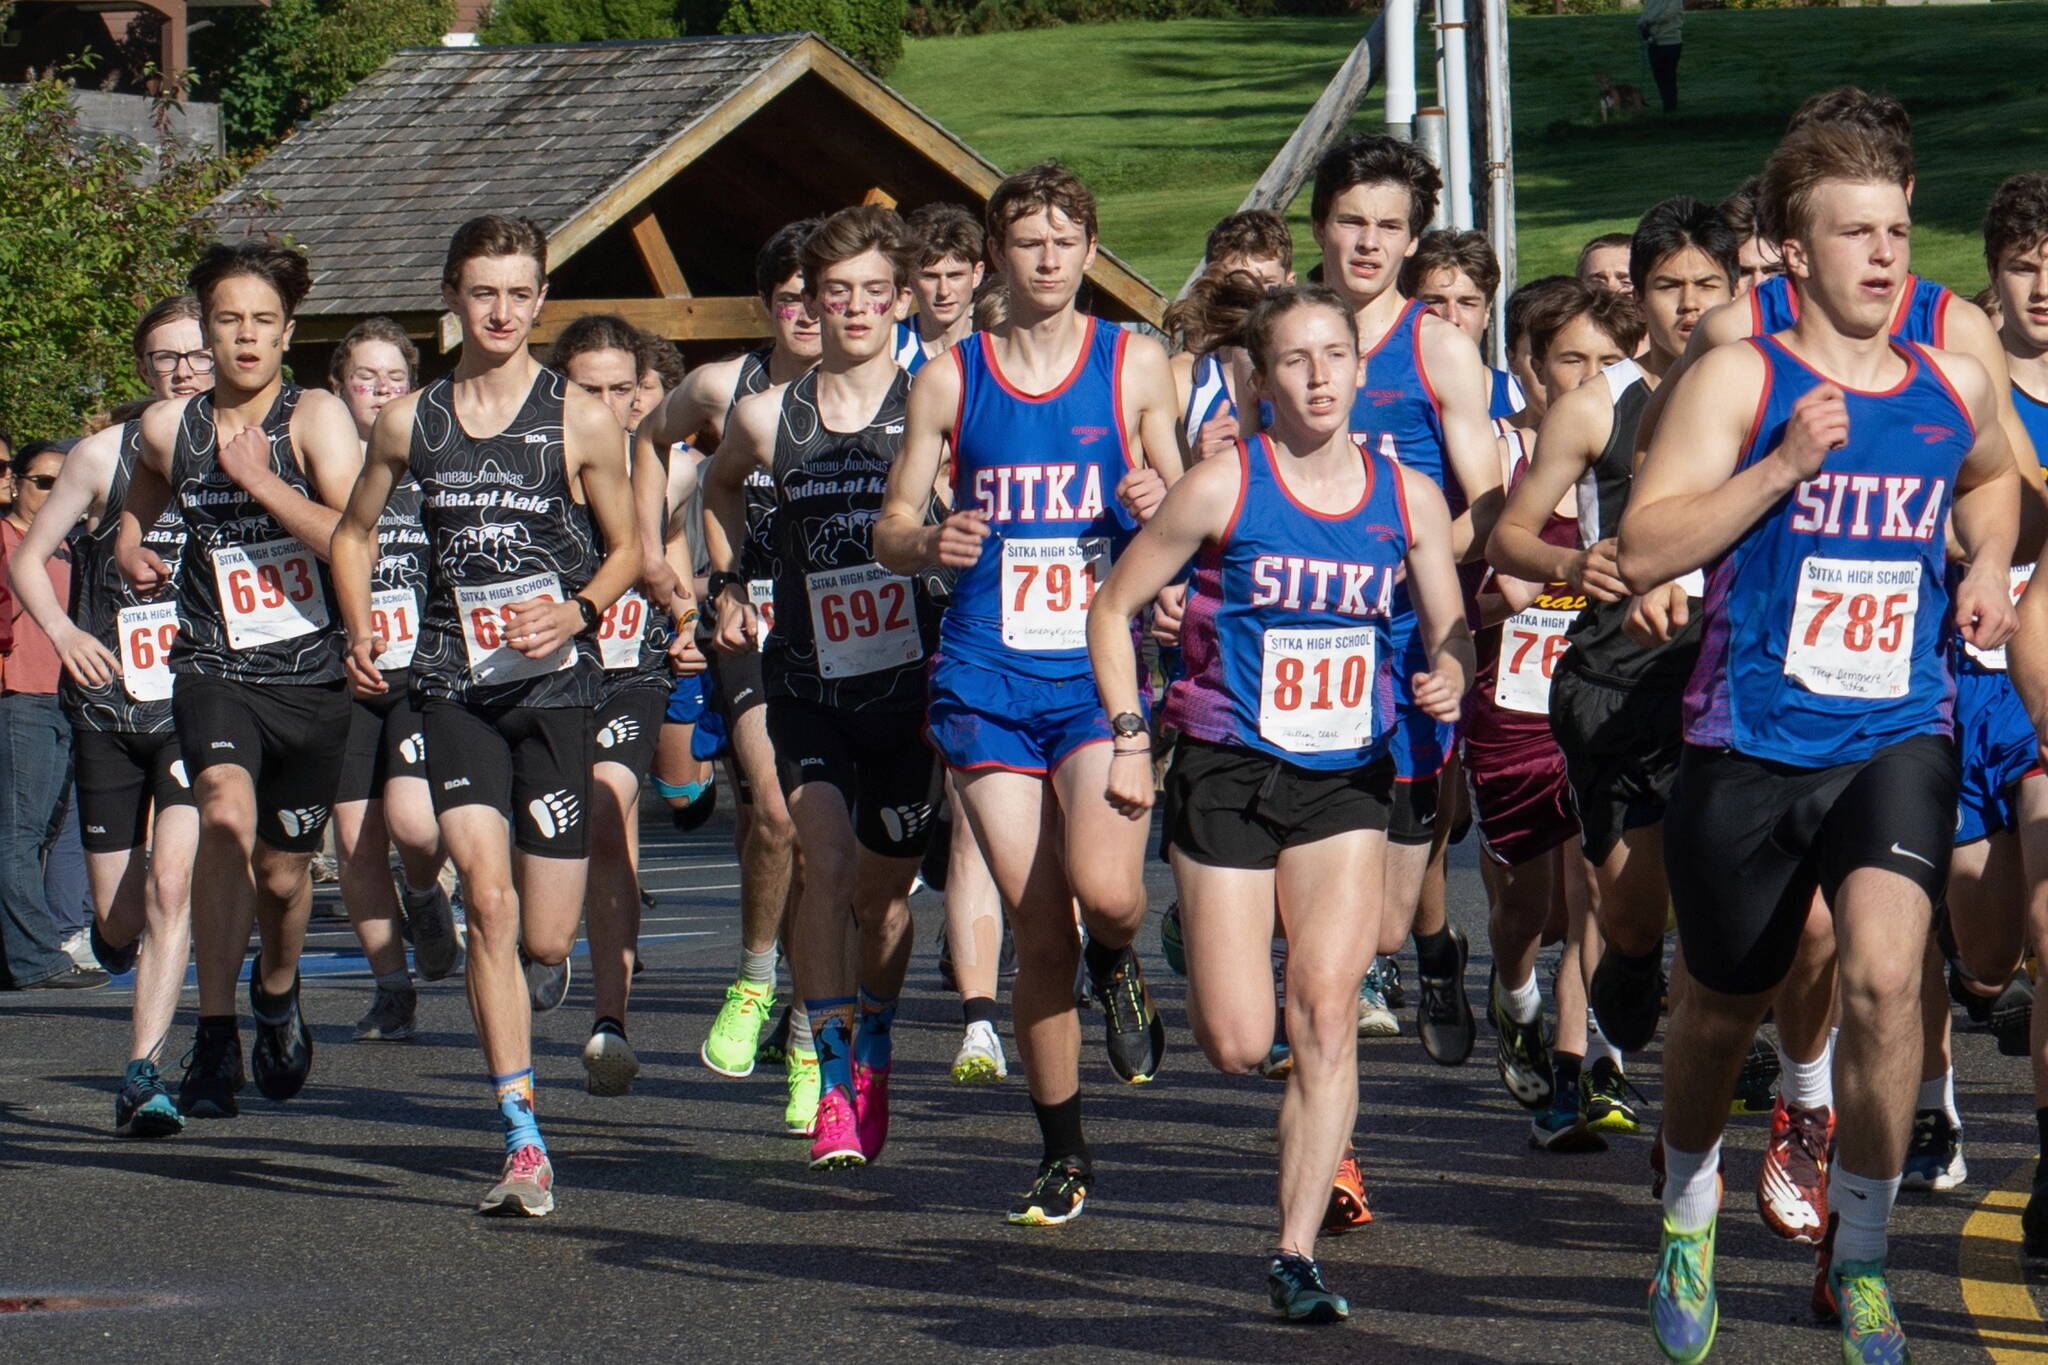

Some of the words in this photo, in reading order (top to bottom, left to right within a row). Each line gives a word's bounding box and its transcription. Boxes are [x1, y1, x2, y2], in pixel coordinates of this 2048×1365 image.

[435, 470, 524, 486] Juneau-Douglas
[974, 463, 1104, 522] SITKA
[1791, 471, 1946, 541] SITKA
[219, 551, 245, 566] SITKA
[248, 548, 269, 562] HIGH
[1008, 545, 1037, 558] SITKA
[1040, 546, 1065, 557] HIGH
[1068, 544, 1105, 556] SCHOOL
[228, 558, 313, 614] 693
[461, 590, 488, 602] SITKA
[489, 587, 513, 600] HIGH
[516, 577, 556, 596] SCHOOL
[753, 584, 773, 597] SITK
[812, 577, 838, 591] SITKA
[840, 573, 864, 586] HIGH
[1013, 564, 1096, 612] 791
[1251, 553, 1395, 619] SITKA
[1808, 565, 1842, 583] SITKA
[1847, 569, 1873, 584] HIGH
[1876, 570, 1914, 585] SCHOOL
[123, 611, 148, 624] SITKA
[150, 609, 172, 620] HIGH
[371, 606, 413, 642] 91
[598, 600, 642, 640] 89
[820, 582, 909, 643] 692
[1509, 614, 1538, 627] SITKA
[1541, 617, 1565, 628] HIGH
[1803, 589, 1908, 653] 785
[130, 623, 179, 670] 69
[1271, 637, 1303, 650] SITKA
[1307, 637, 1332, 650] HIGH
[1335, 633, 1371, 648] SCHOOL
[1509, 630, 1570, 679] 76
[1273, 655, 1366, 711] 810
